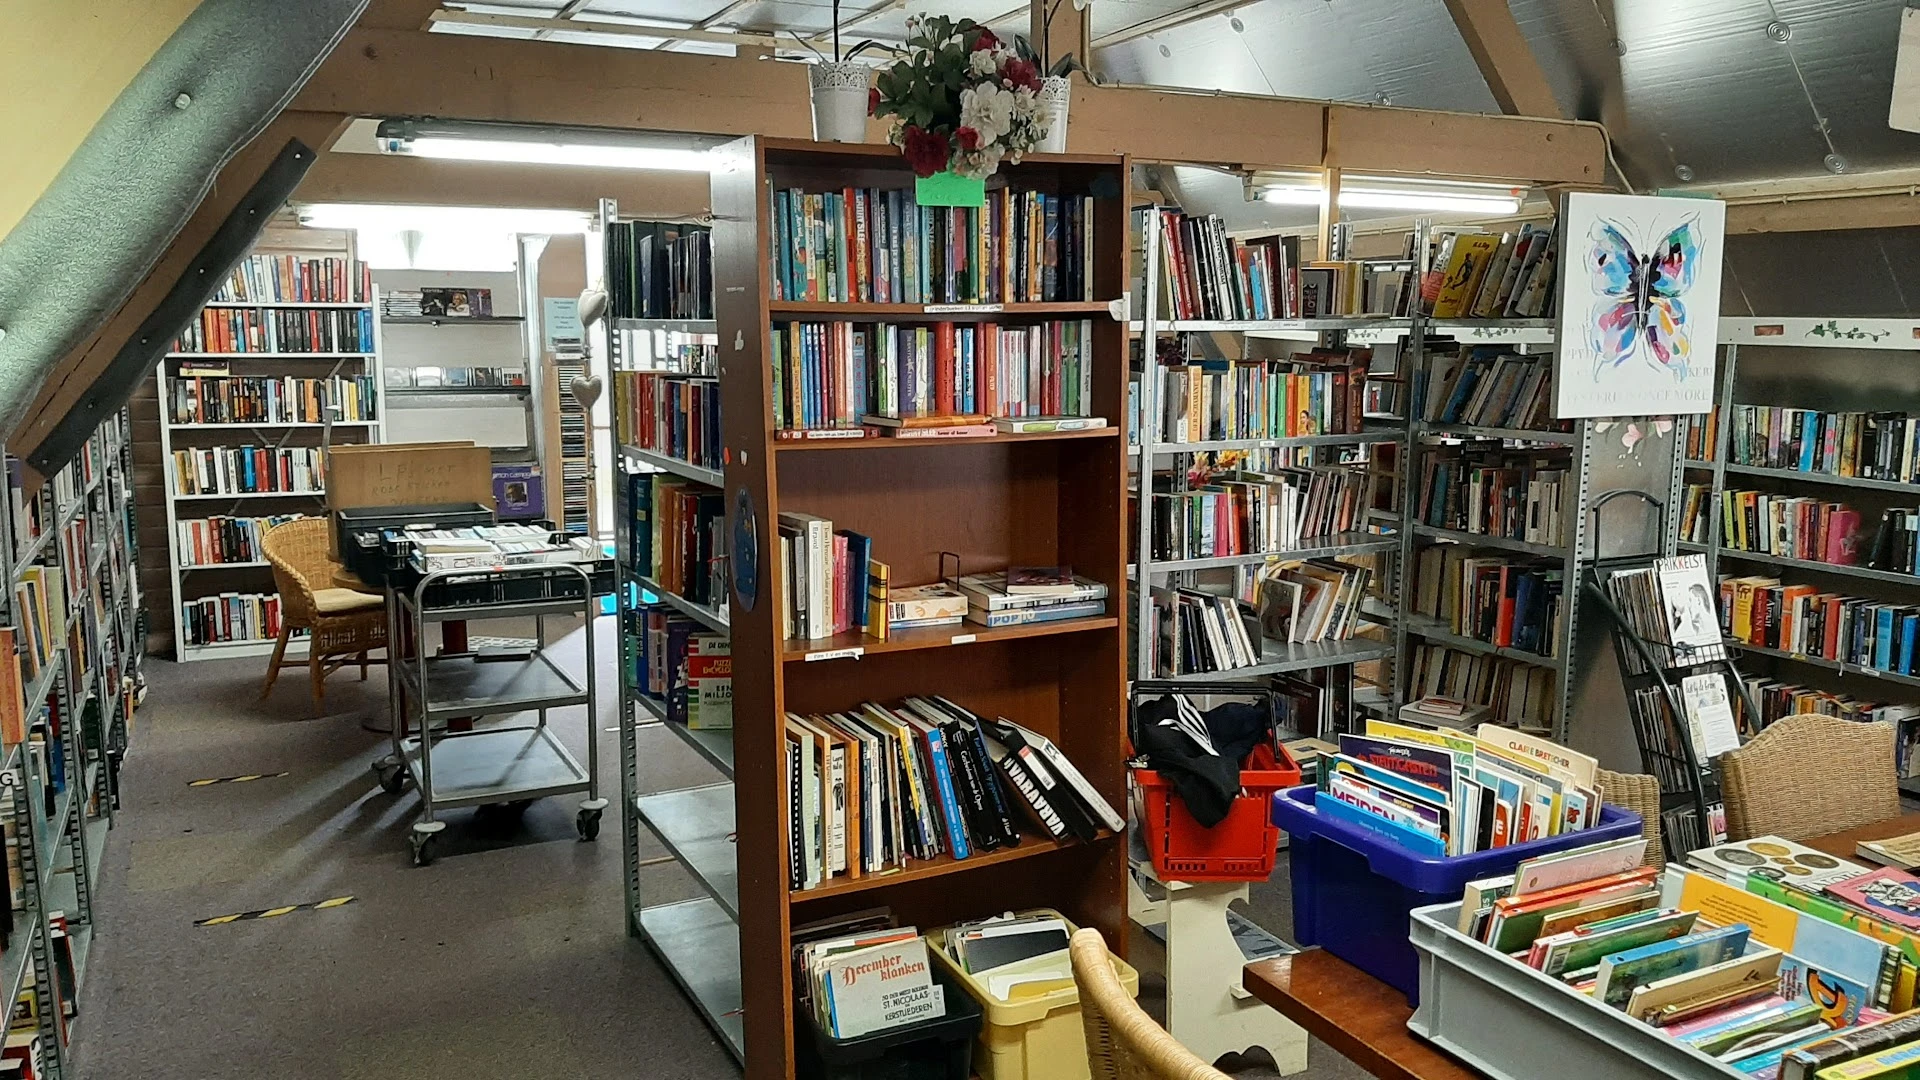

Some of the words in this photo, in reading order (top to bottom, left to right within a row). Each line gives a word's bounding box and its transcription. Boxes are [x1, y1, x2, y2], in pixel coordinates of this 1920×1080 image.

[1658, 553, 1703, 572] PRIKKELS!
[1509, 740, 1535, 756] CLAIRE
[0, 772, 14, 787] G
[880, 961, 926, 982] klanken
